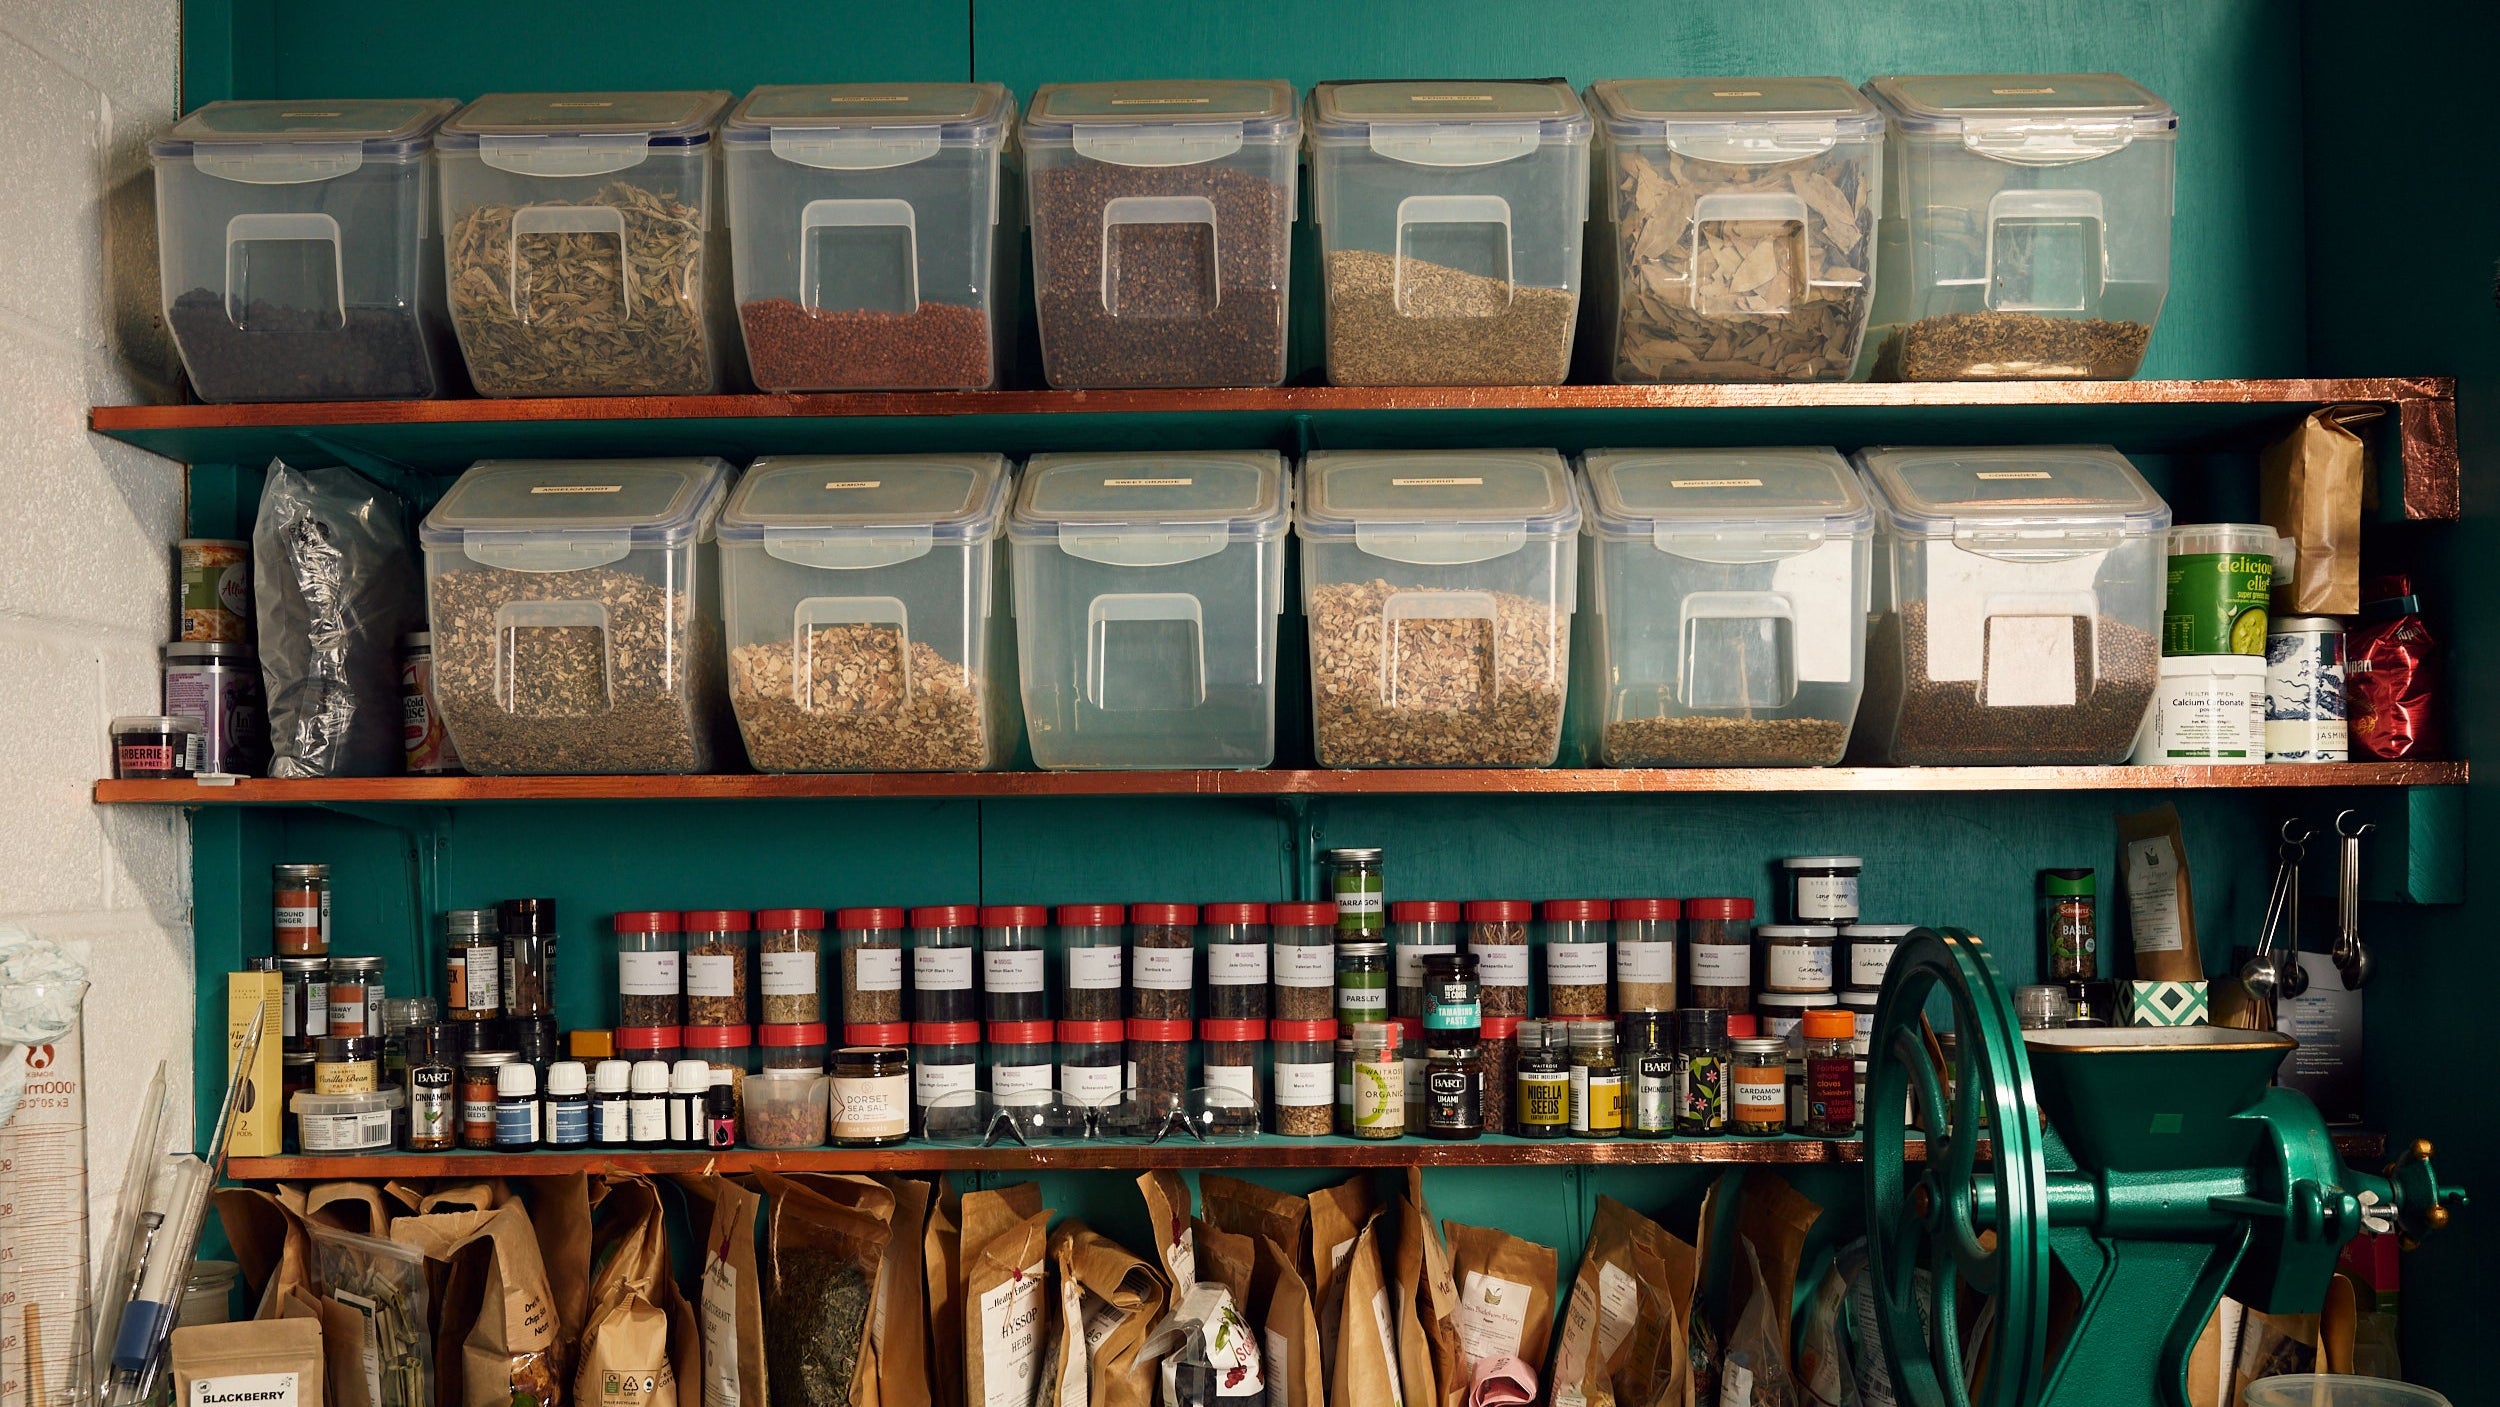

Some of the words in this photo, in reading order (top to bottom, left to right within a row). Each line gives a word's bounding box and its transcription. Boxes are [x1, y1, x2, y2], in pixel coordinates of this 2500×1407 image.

[2218, 556, 2271, 573] deliciou
[1339, 898, 1379, 907] TARRAGON
[2063, 925, 2089, 936] BASIL
[1347, 995, 1380, 1003] PARSLEY
[1445, 1016, 1467, 1025] PASTE
[1643, 1062, 1671, 1073] BART
[418, 1072, 449, 1083] BART
[1434, 1079, 1462, 1089] BART
[1365, 1090, 1403, 1099] ORGANIC
[1527, 1084, 1562, 1100] NIGELLA
[1740, 1087, 1781, 1095] CARDAMOM
[415, 1093, 451, 1102] CINNAMON
[848, 1094, 889, 1104] DORSET
[1437, 1094, 1459, 1104] UMAMI
[847, 1103, 865, 1112] SEA
[867, 1103, 889, 1112] SALT
[1371, 1107, 1400, 1115] Oregano
[1531, 1100, 1560, 1115] SEEDS
[241, 1120, 248, 1130] 2
[1001, 1307, 1038, 1339] HYSSOP
[1010, 1333, 1033, 1354] HERB
[658, 1376, 674, 1388] COFF
[203, 1390, 285, 1404] BLACKBERRY
